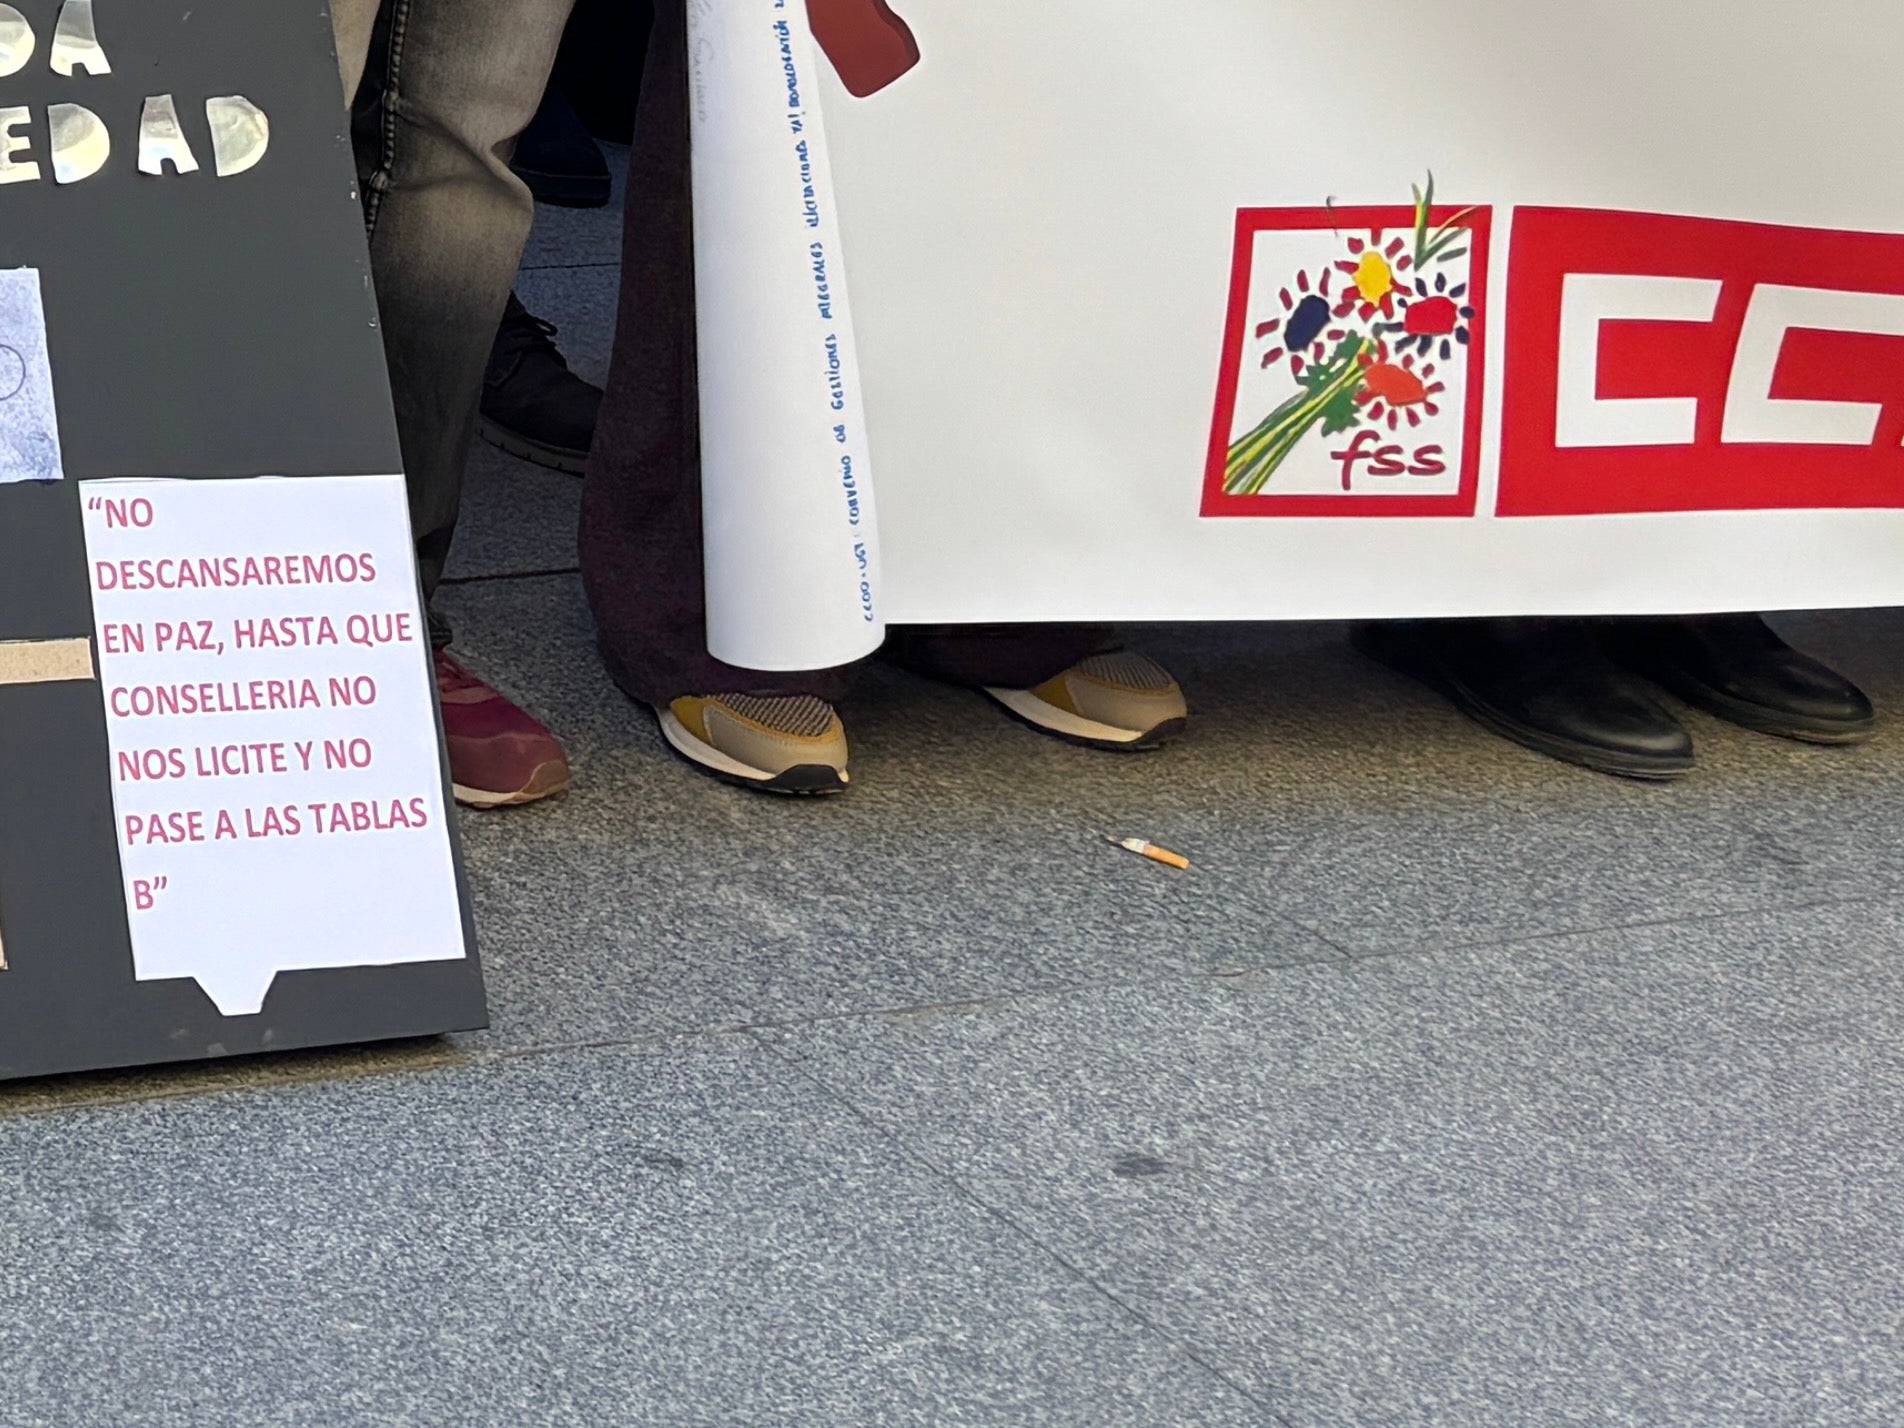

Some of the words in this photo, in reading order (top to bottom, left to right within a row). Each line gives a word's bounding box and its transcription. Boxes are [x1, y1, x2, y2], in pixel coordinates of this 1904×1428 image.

[1330, 430, 1447, 490] fss
[97, 555, 375, 589] DESCANSAREMOS
[105, 625, 143, 652] EN
[156, 621, 225, 656] PAZ,
[236, 618, 337, 646] HASTA
[348, 615, 409, 645] QUE
[113, 680, 318, 716] CONSELLERIA
[330, 677, 375, 705] NO
[120, 749, 185, 779] NOS
[197, 744, 283, 775] LICITE
[298, 745, 311, 769] Y
[325, 740, 370, 767] NO
[127, 813, 201, 842] PASE
[217, 811, 235, 837] A
[247, 807, 300, 836] LAS
[310, 800, 426, 831] TABLAS
